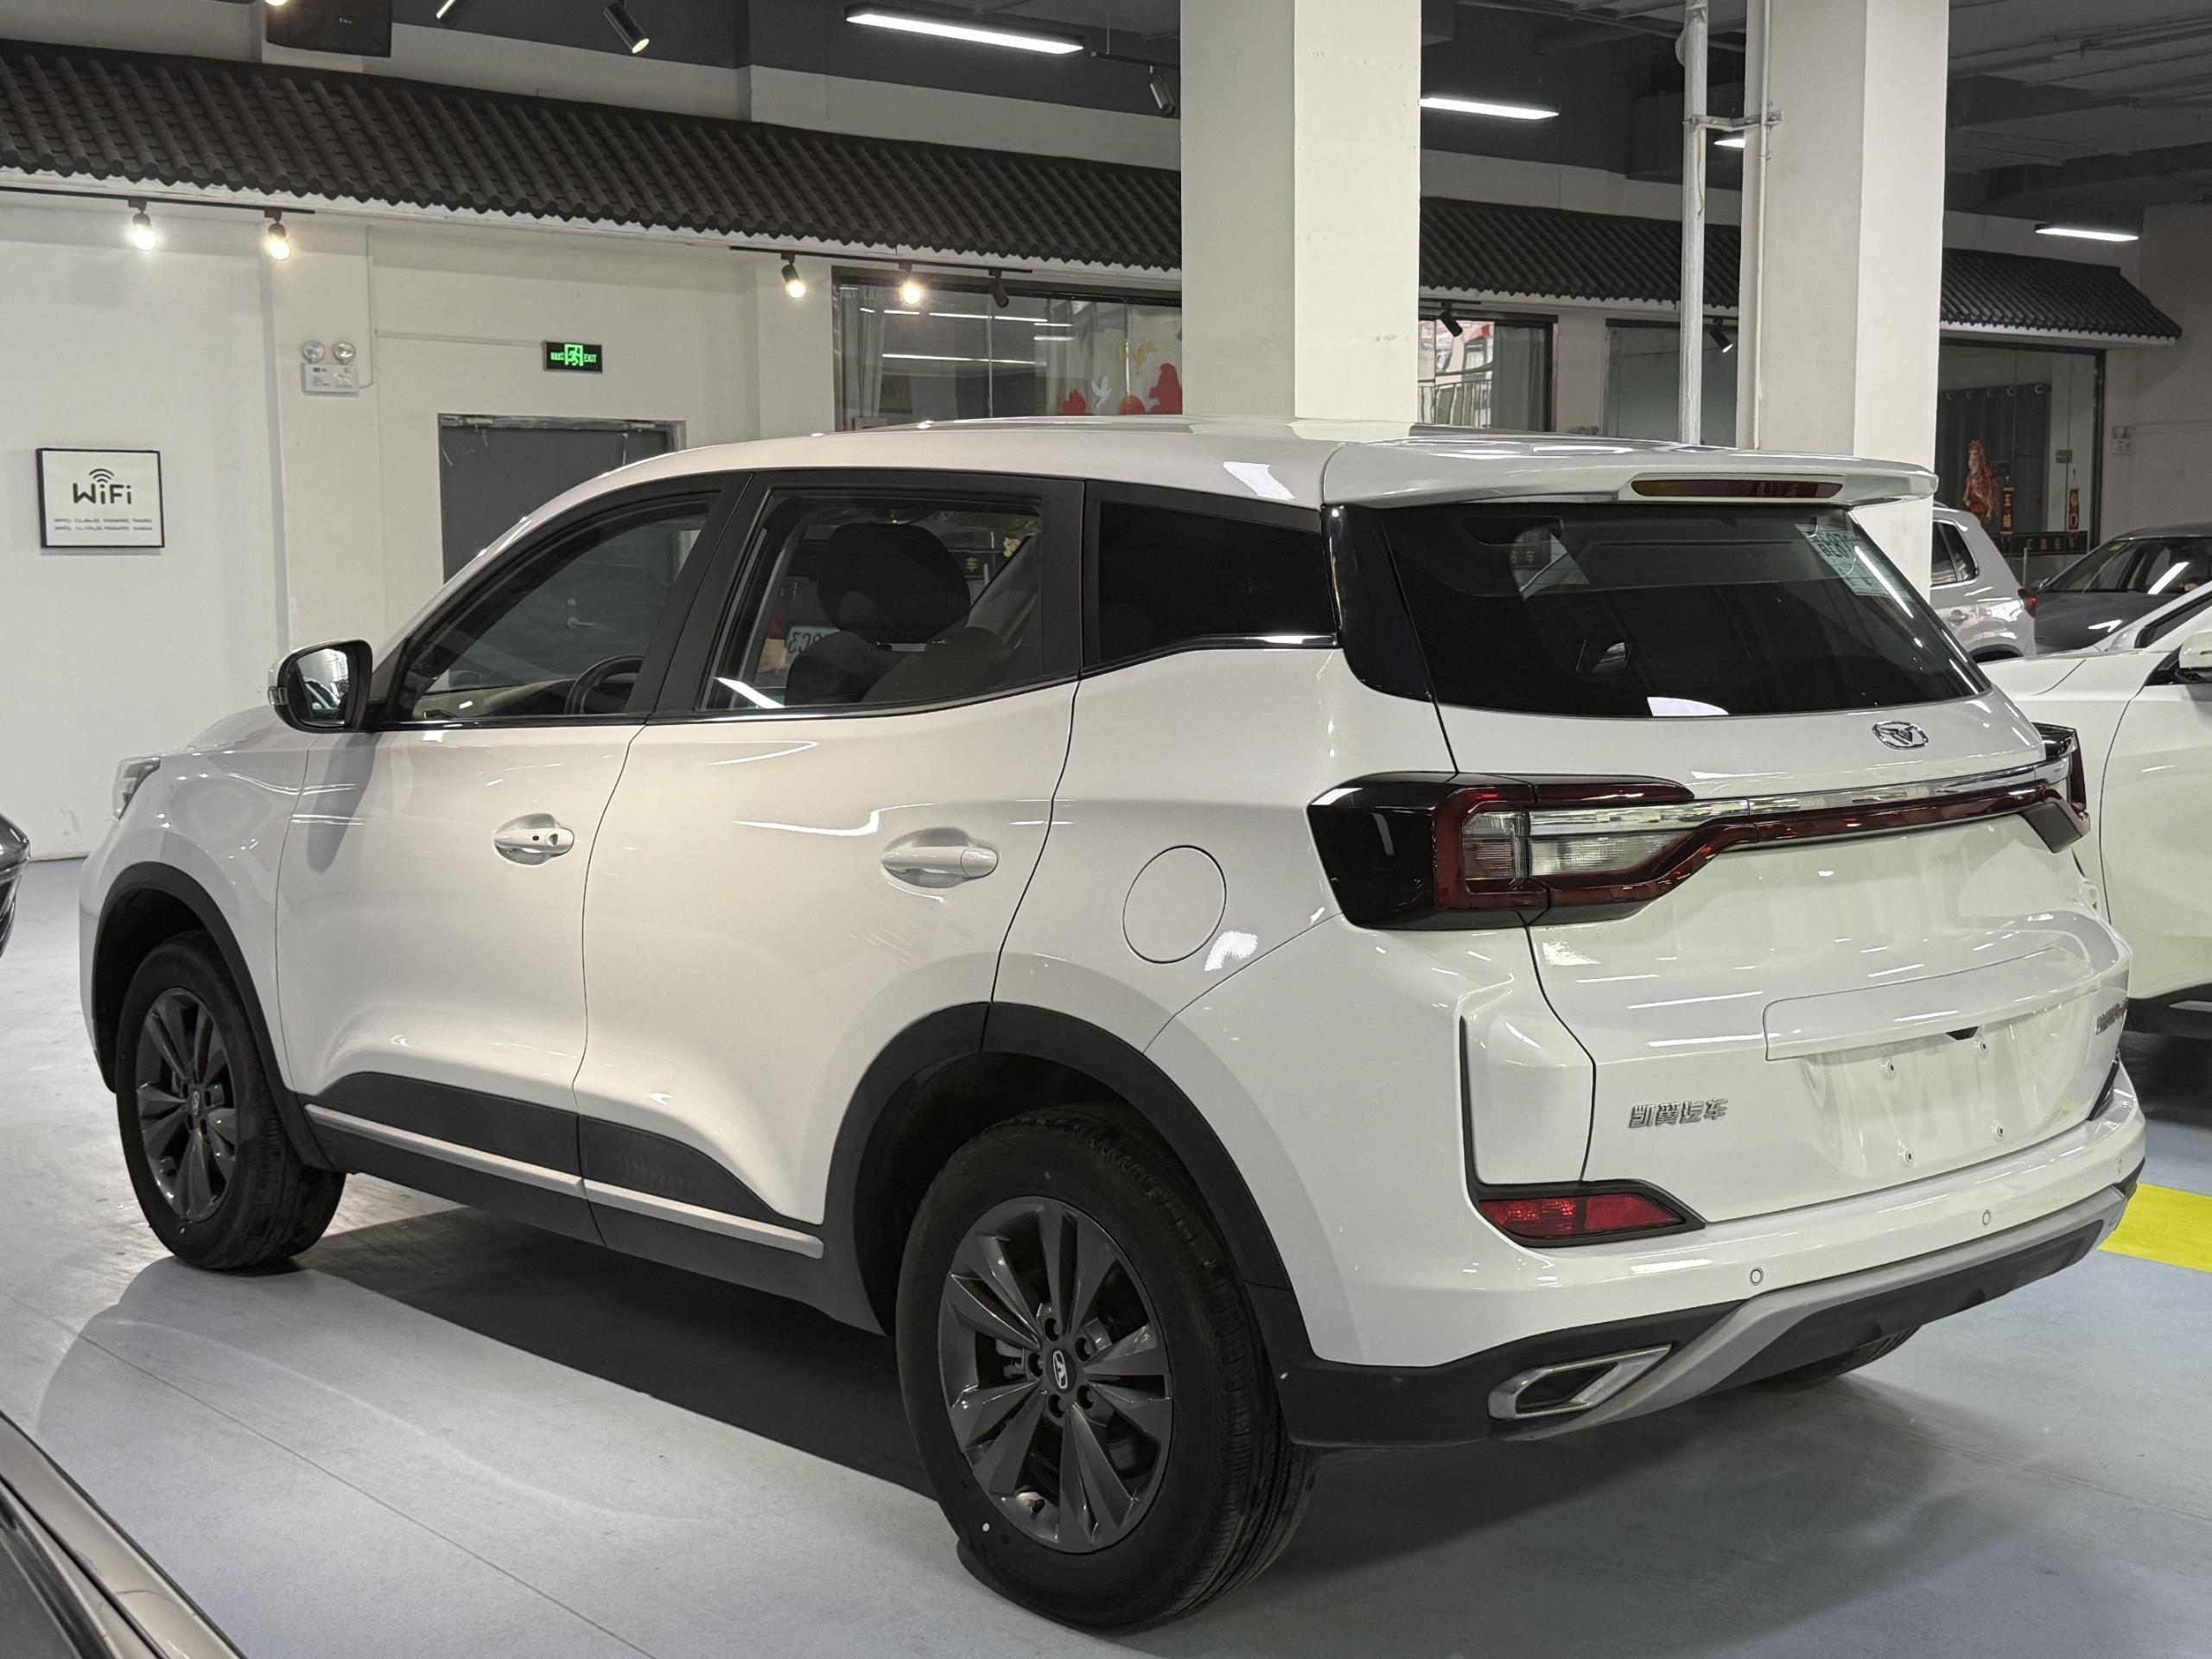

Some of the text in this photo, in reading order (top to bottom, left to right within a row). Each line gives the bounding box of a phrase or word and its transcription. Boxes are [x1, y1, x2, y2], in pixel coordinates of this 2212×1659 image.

[583, 353, 597, 363] EXIT
[73, 482, 132, 505] WiFi
[1629, 1097, 1729, 1128] 凯翼汽车
